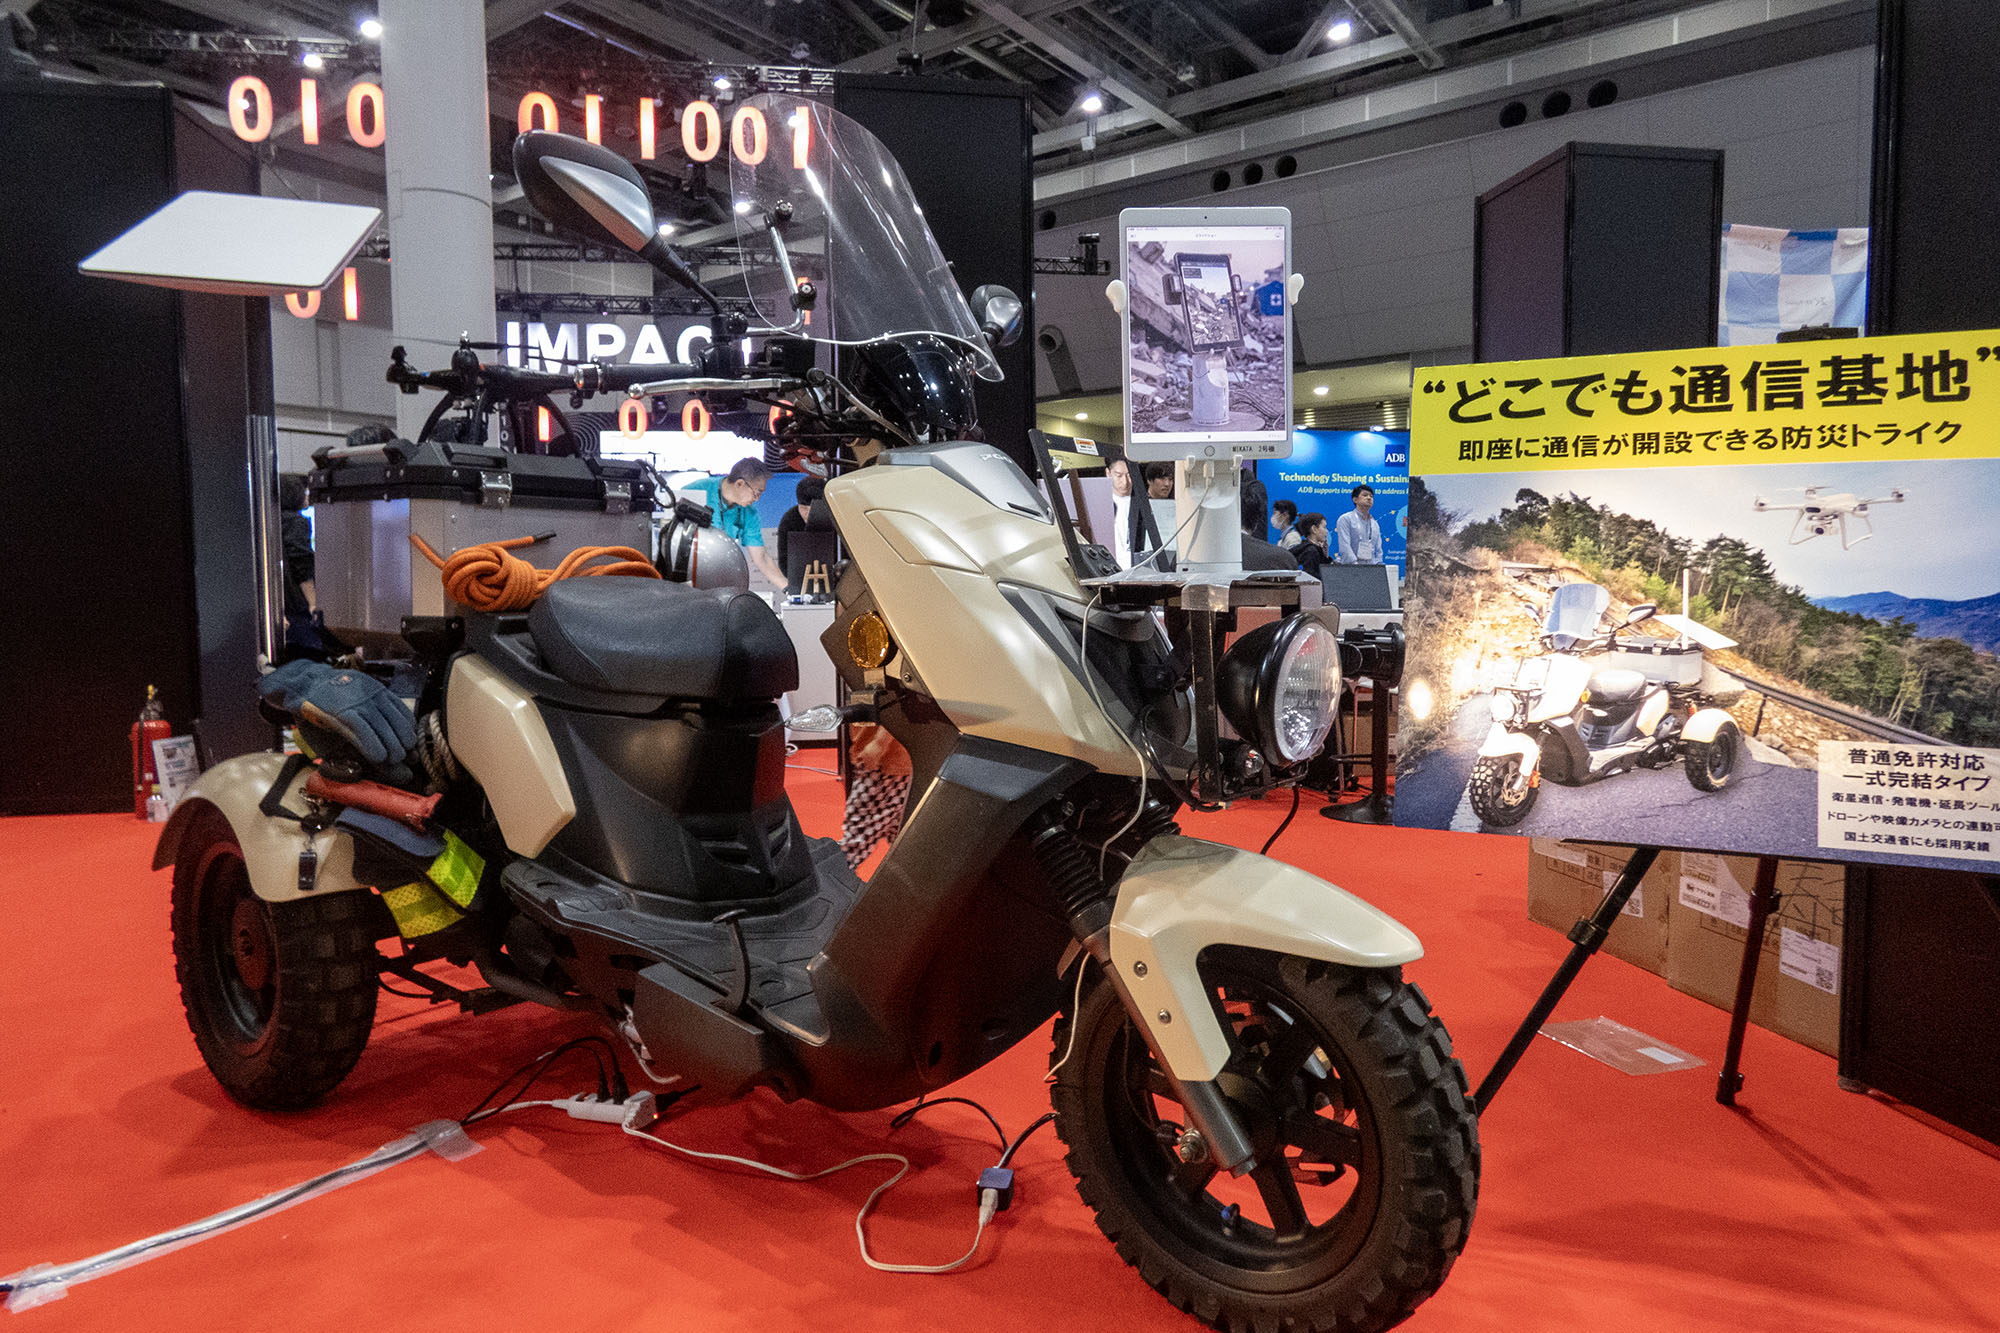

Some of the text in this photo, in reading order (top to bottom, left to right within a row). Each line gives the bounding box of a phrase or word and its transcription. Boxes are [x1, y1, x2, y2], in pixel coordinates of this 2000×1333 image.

[506, 321, 752, 374] IMPAC
[1458, 420, 1963, 461] 即座に通信が開設できる防災トライク
[1385, 453, 1406, 463] ADB
[1279, 472, 1330, 484] Technology
[1331, 473, 1367, 486] Shaping
[1382, 487, 1405, 495] address
[1848, 748, 1986, 771] 普通免許対応
[1843, 770, 1992, 791] 一式完結タイプ
[1844, 832, 1991, 852] 国土交通省にも採用実績
